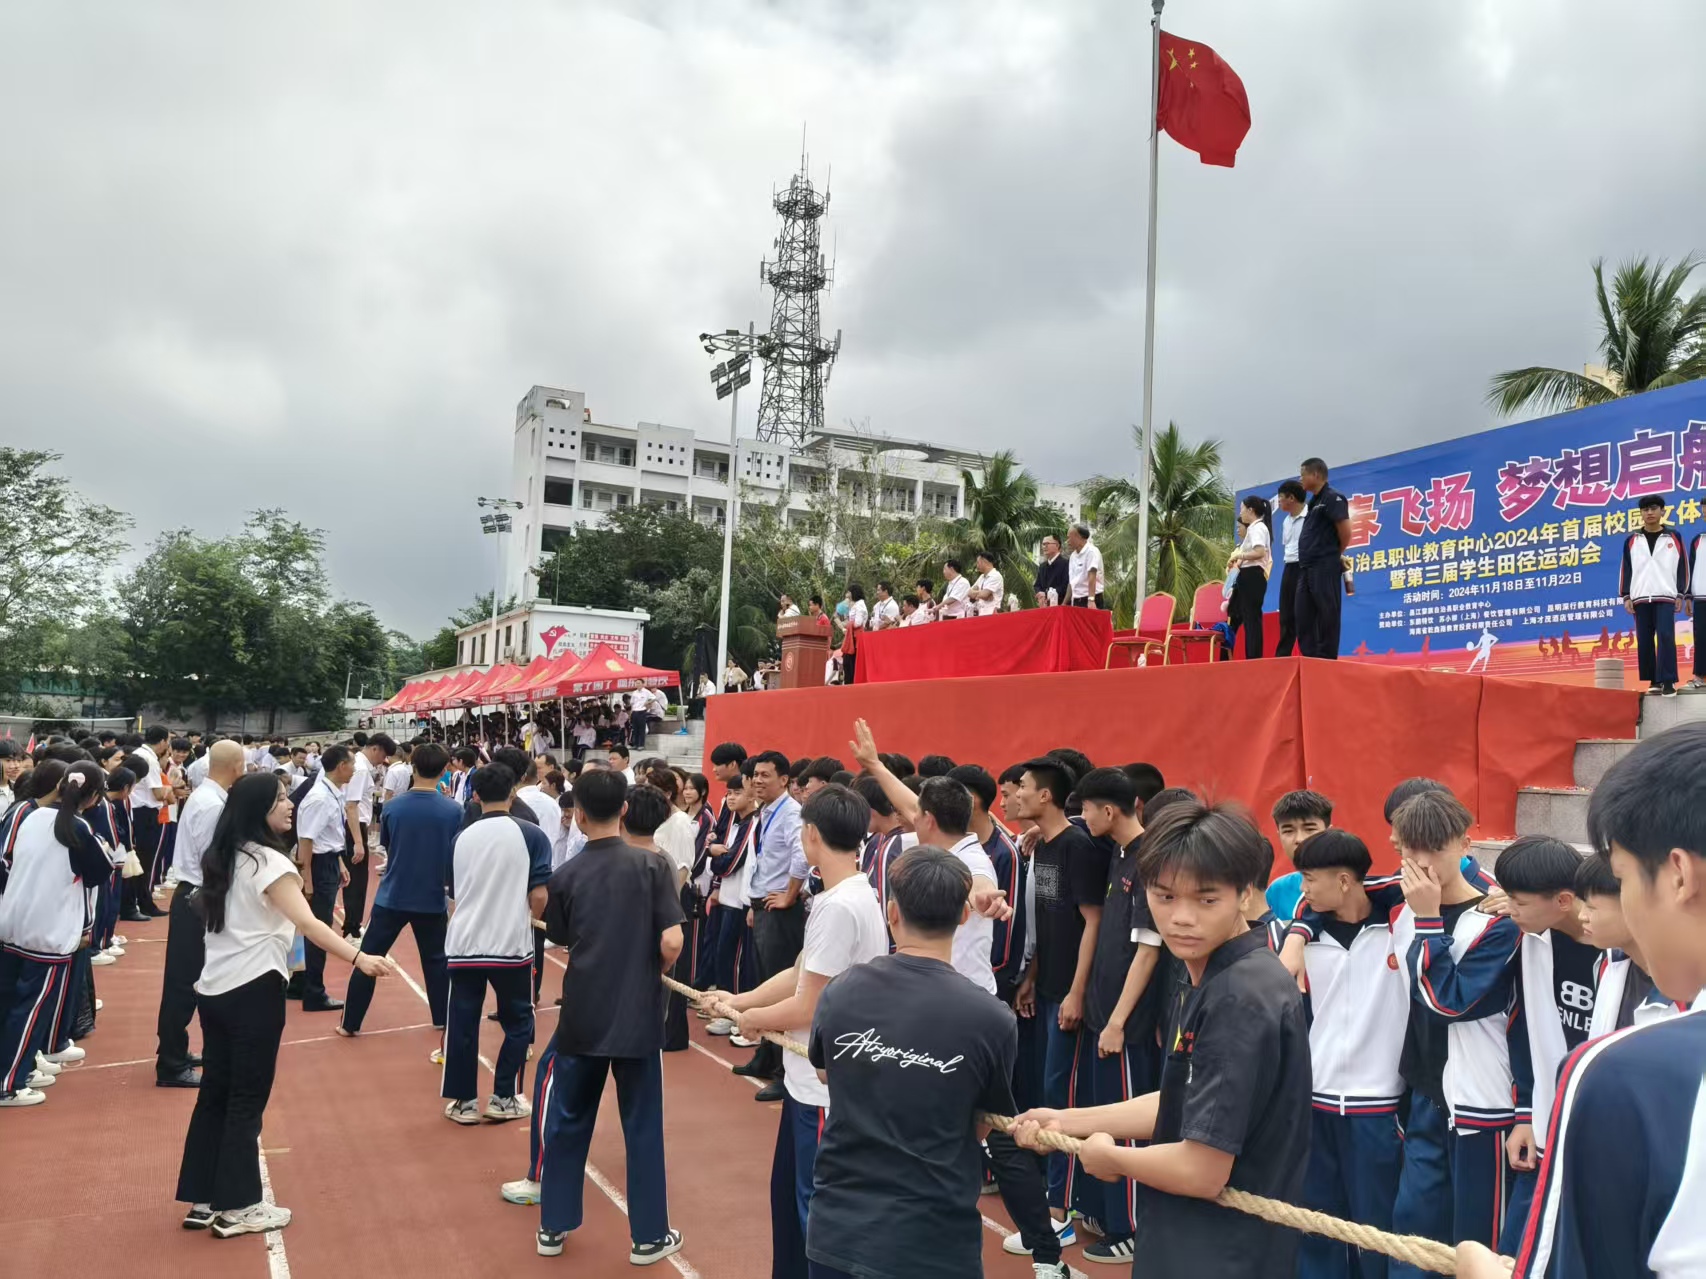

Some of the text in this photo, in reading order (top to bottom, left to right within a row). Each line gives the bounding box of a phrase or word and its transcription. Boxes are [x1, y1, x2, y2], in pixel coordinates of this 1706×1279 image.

[1390, 541, 1602, 590] 暨第三届学生田径运动会
